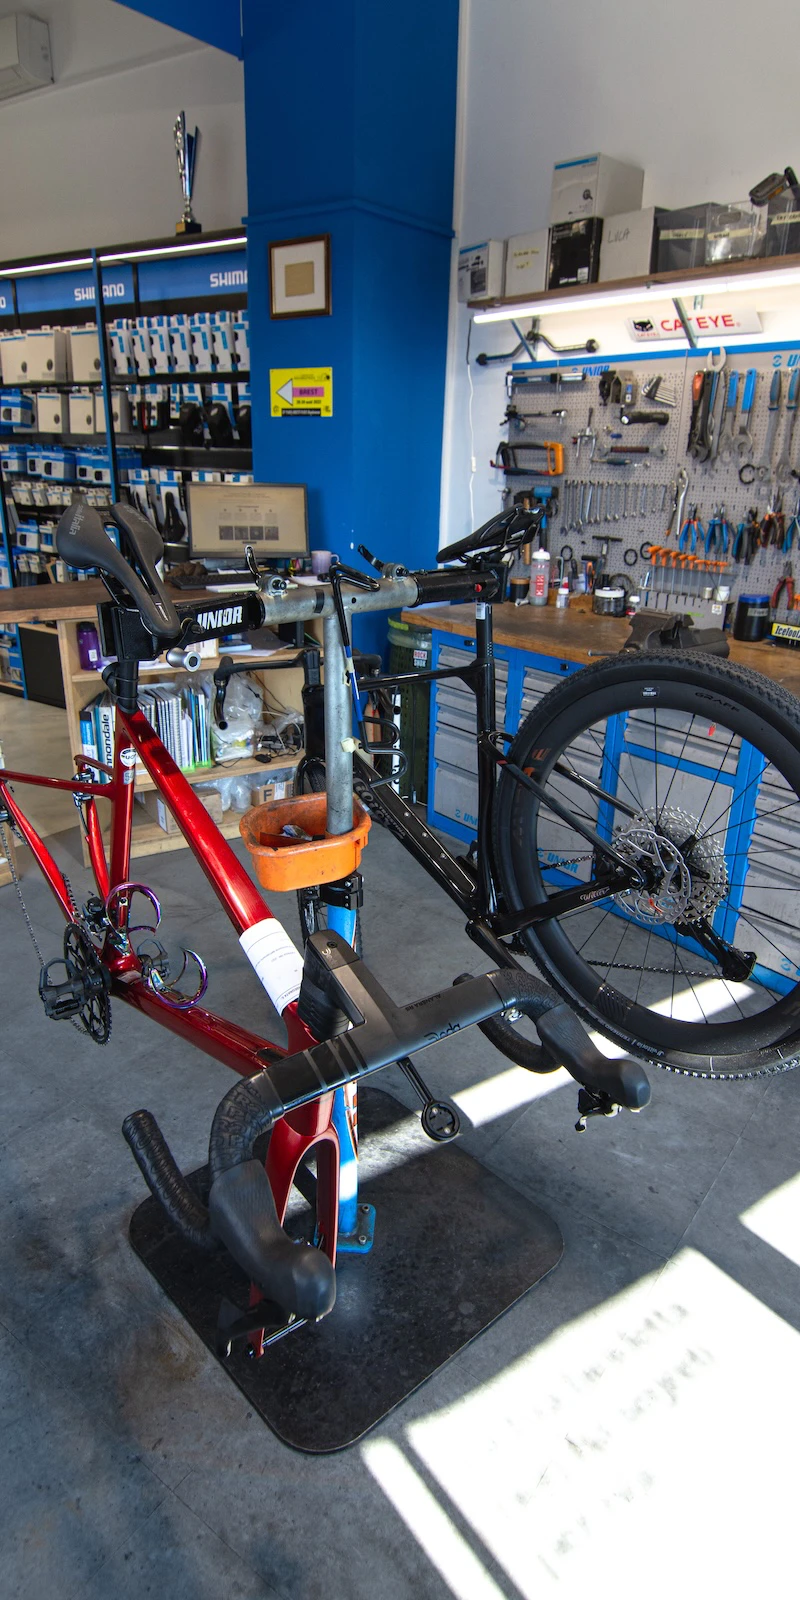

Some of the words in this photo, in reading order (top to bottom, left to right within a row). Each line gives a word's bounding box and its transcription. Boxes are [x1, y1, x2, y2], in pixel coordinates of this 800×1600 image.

[660, 314, 735, 332] CAEYE
[197, 605, 243, 630] UNIOR
[102, 713, 113, 781] nnondale
